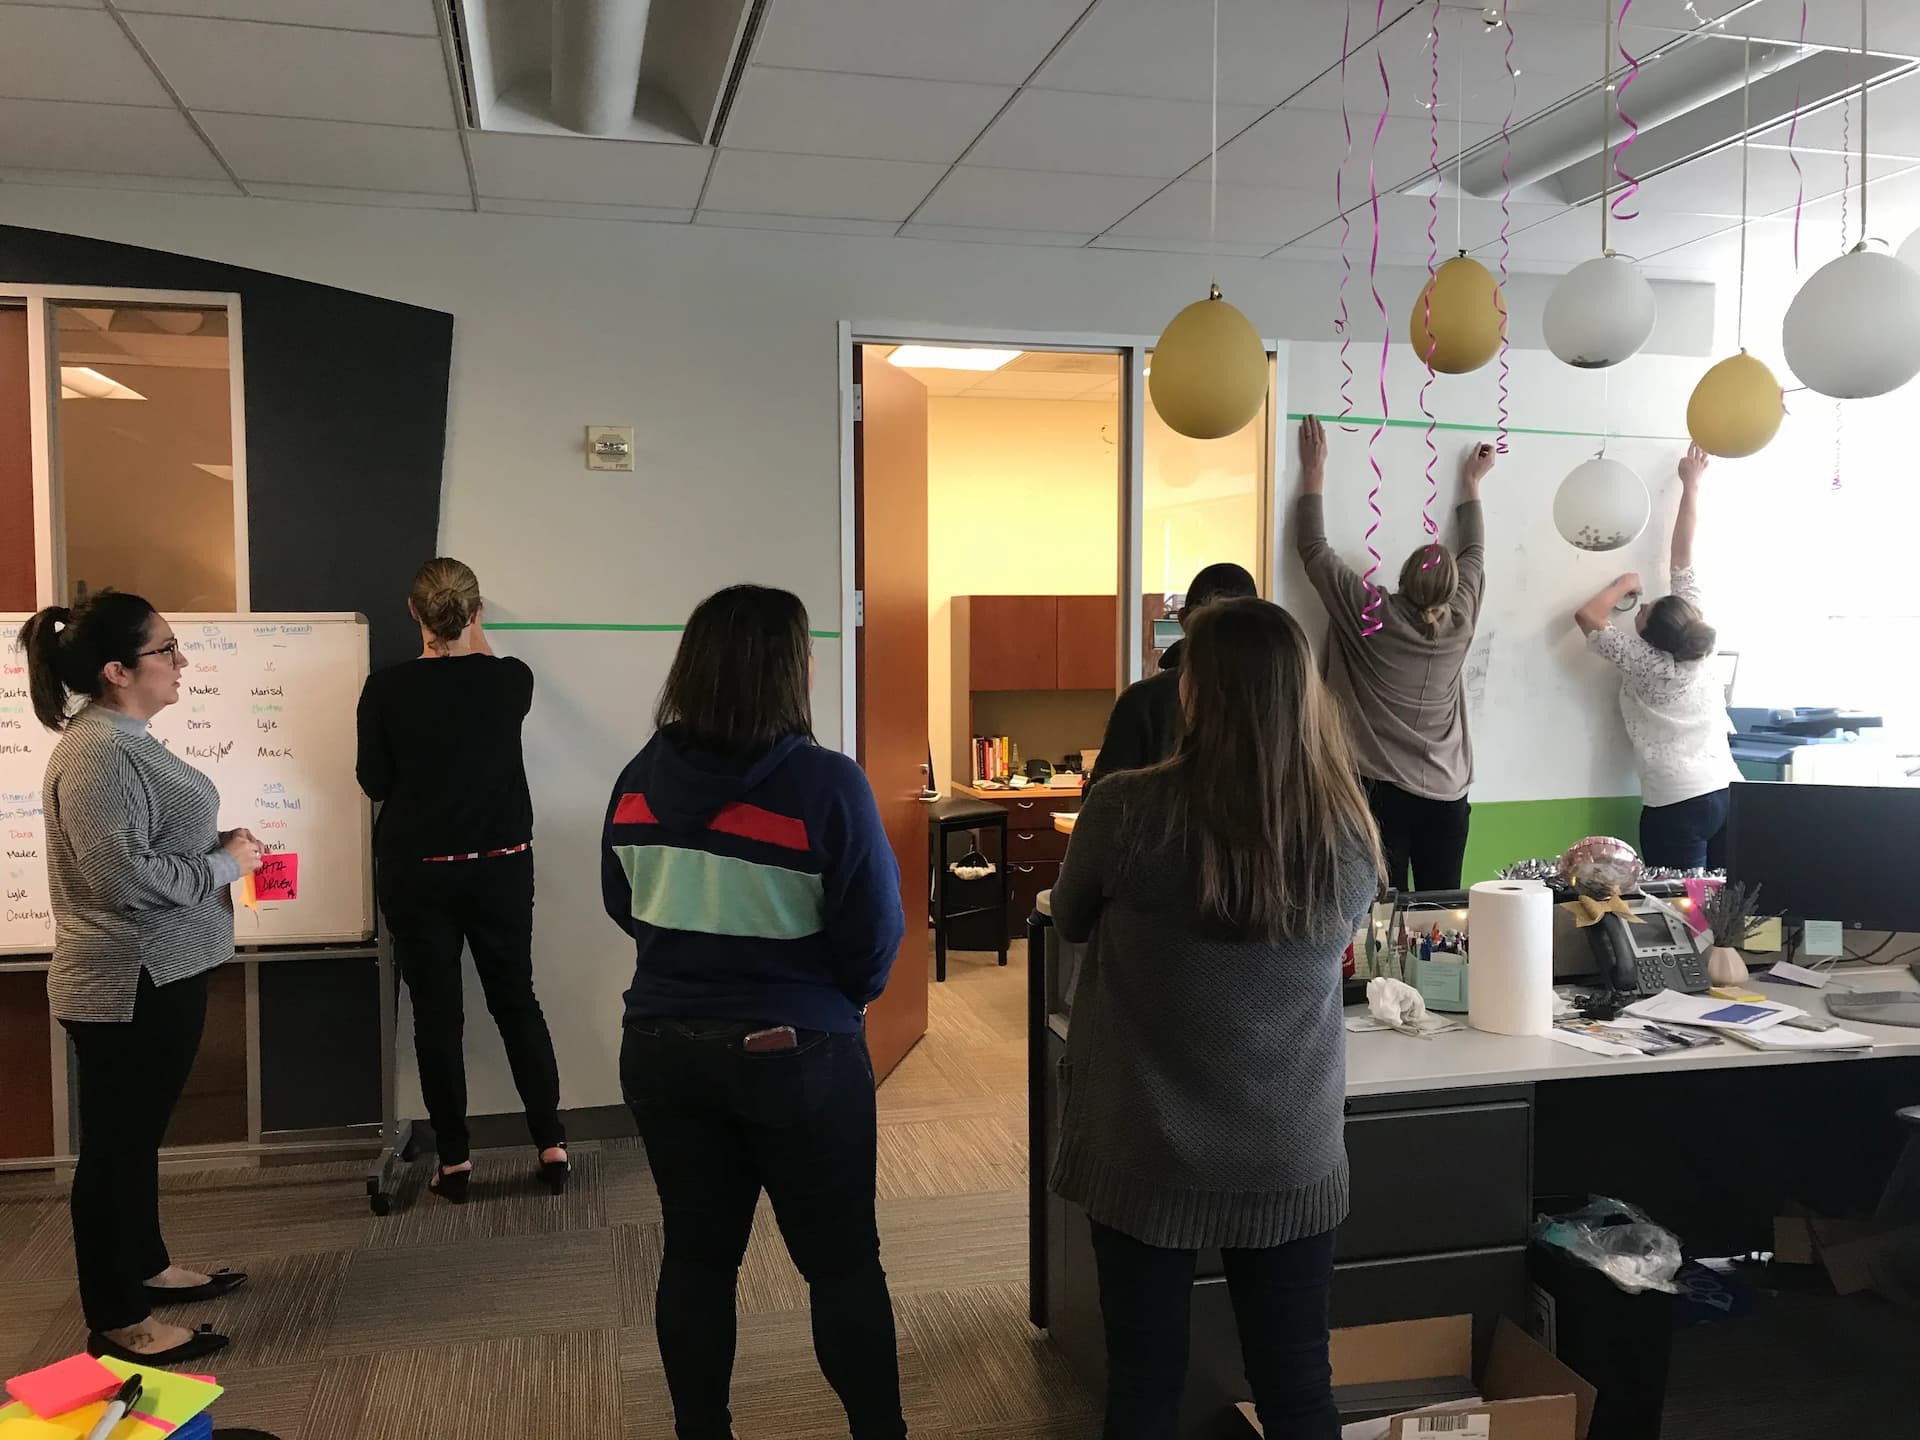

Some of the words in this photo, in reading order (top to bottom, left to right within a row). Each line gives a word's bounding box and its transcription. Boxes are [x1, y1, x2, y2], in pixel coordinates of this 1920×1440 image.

[187, 720, 211, 729] Chris
[257, 720, 278, 733] Lyle
[257, 746, 295, 759] Mack
[7, 888, 28, 902] Lyle
[6, 909, 51, 929] Courtney
